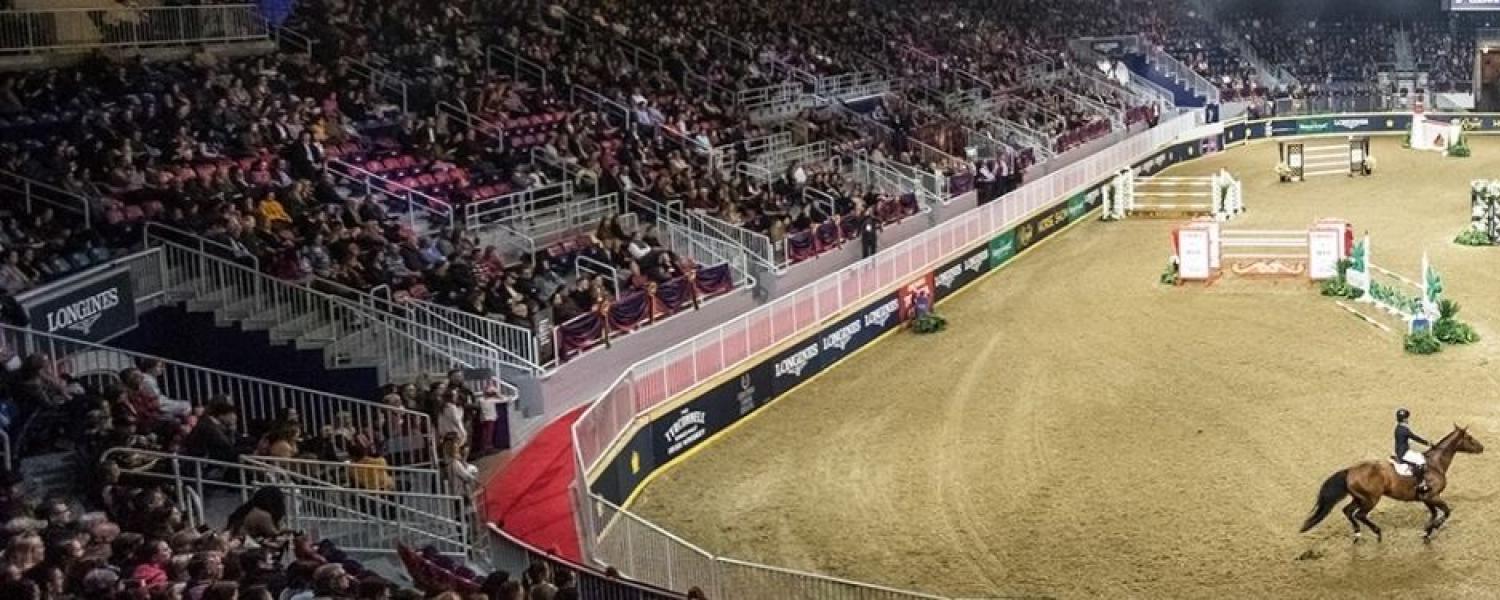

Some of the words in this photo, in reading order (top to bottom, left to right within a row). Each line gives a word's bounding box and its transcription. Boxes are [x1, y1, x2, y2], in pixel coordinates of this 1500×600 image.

[47, 287, 119, 331] LONGINES
[823, 319, 861, 350] LONGINES
[775, 343, 819, 377] LONGINES
